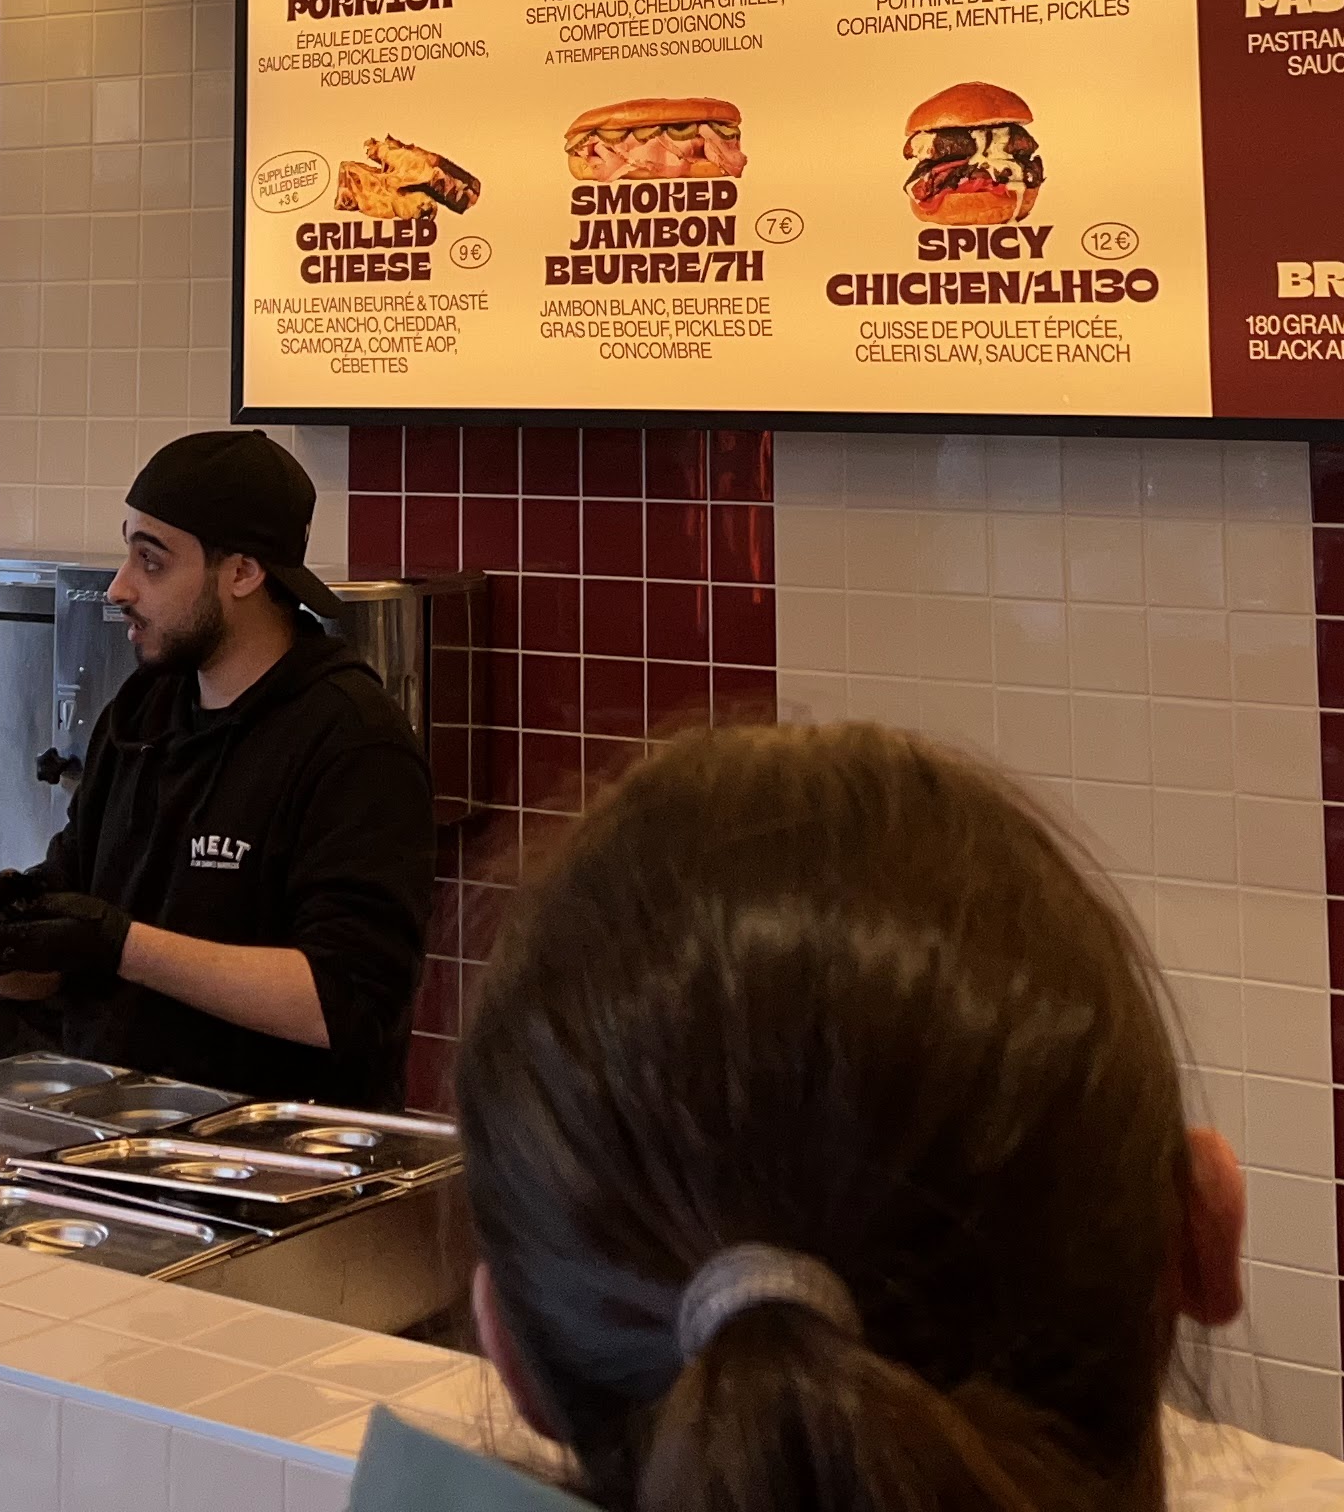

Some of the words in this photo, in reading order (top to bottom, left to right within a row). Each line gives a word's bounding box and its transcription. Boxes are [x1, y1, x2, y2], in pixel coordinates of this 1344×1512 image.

[836, 10, 952, 37] CORIANDRE,
[956, 4, 1043, 28] MENTHE,
[296, 30, 351, 50] ÉPAULE
[352, 28, 374, 46] DE
[374, 22, 442, 44] COCHON
[258, 54, 301, 74] SAUCE
[302, 51, 336, 69] BBQ,
[338, 46, 399, 67] PICKLES
[400, 39, 489, 62] D'OIGNONS,
[320, 68, 371, 88] KOBUS
[372, 65, 416, 84] SLAW
[570, 180, 738, 216] SMOKED
[295, 217, 438, 252] GRILLED
[569, 215, 737, 251] JAMBON
[918, 225, 1054, 262] SPICY
[300, 251, 432, 284] CHEESE
[544, 250, 764, 286] BEURRE/7H
[826, 268, 1159, 307] CHICKEN/1H30
[254, 298, 282, 315] PAIN
[282, 297, 302, 314] AU
[303, 296, 352, 314] LEVAIN
[354, 290, 416, 313] BEURRÉ
[416, 294, 428, 312] &
[428, 289, 489, 312] TOASTÉ
[859, 320, 929, 340] CUISSE
[931, 320, 959, 339] DE
[961, 320, 1041, 340] POULET
[1044, 314, 1123, 342] ÉPICÉE,
[1245, 314, 1281, 336] 180
[280, 337, 367, 358] SCAMORZA,
[368, 332, 424, 354] COMTÉ
[424, 335, 458, 356] AOP,
[599, 341, 713, 360] CONCOMBRE
[855, 339, 921, 363] CÉLERI
[924, 343, 983, 366] SLAW,
[985, 343, 1054, 363] SAUCE
[1056, 343, 1131, 363] RANCH
[1248, 339, 1324, 361] BLACK
[330, 353, 409, 374] CÉBETTES
[191, 835, 252, 862] MELT
